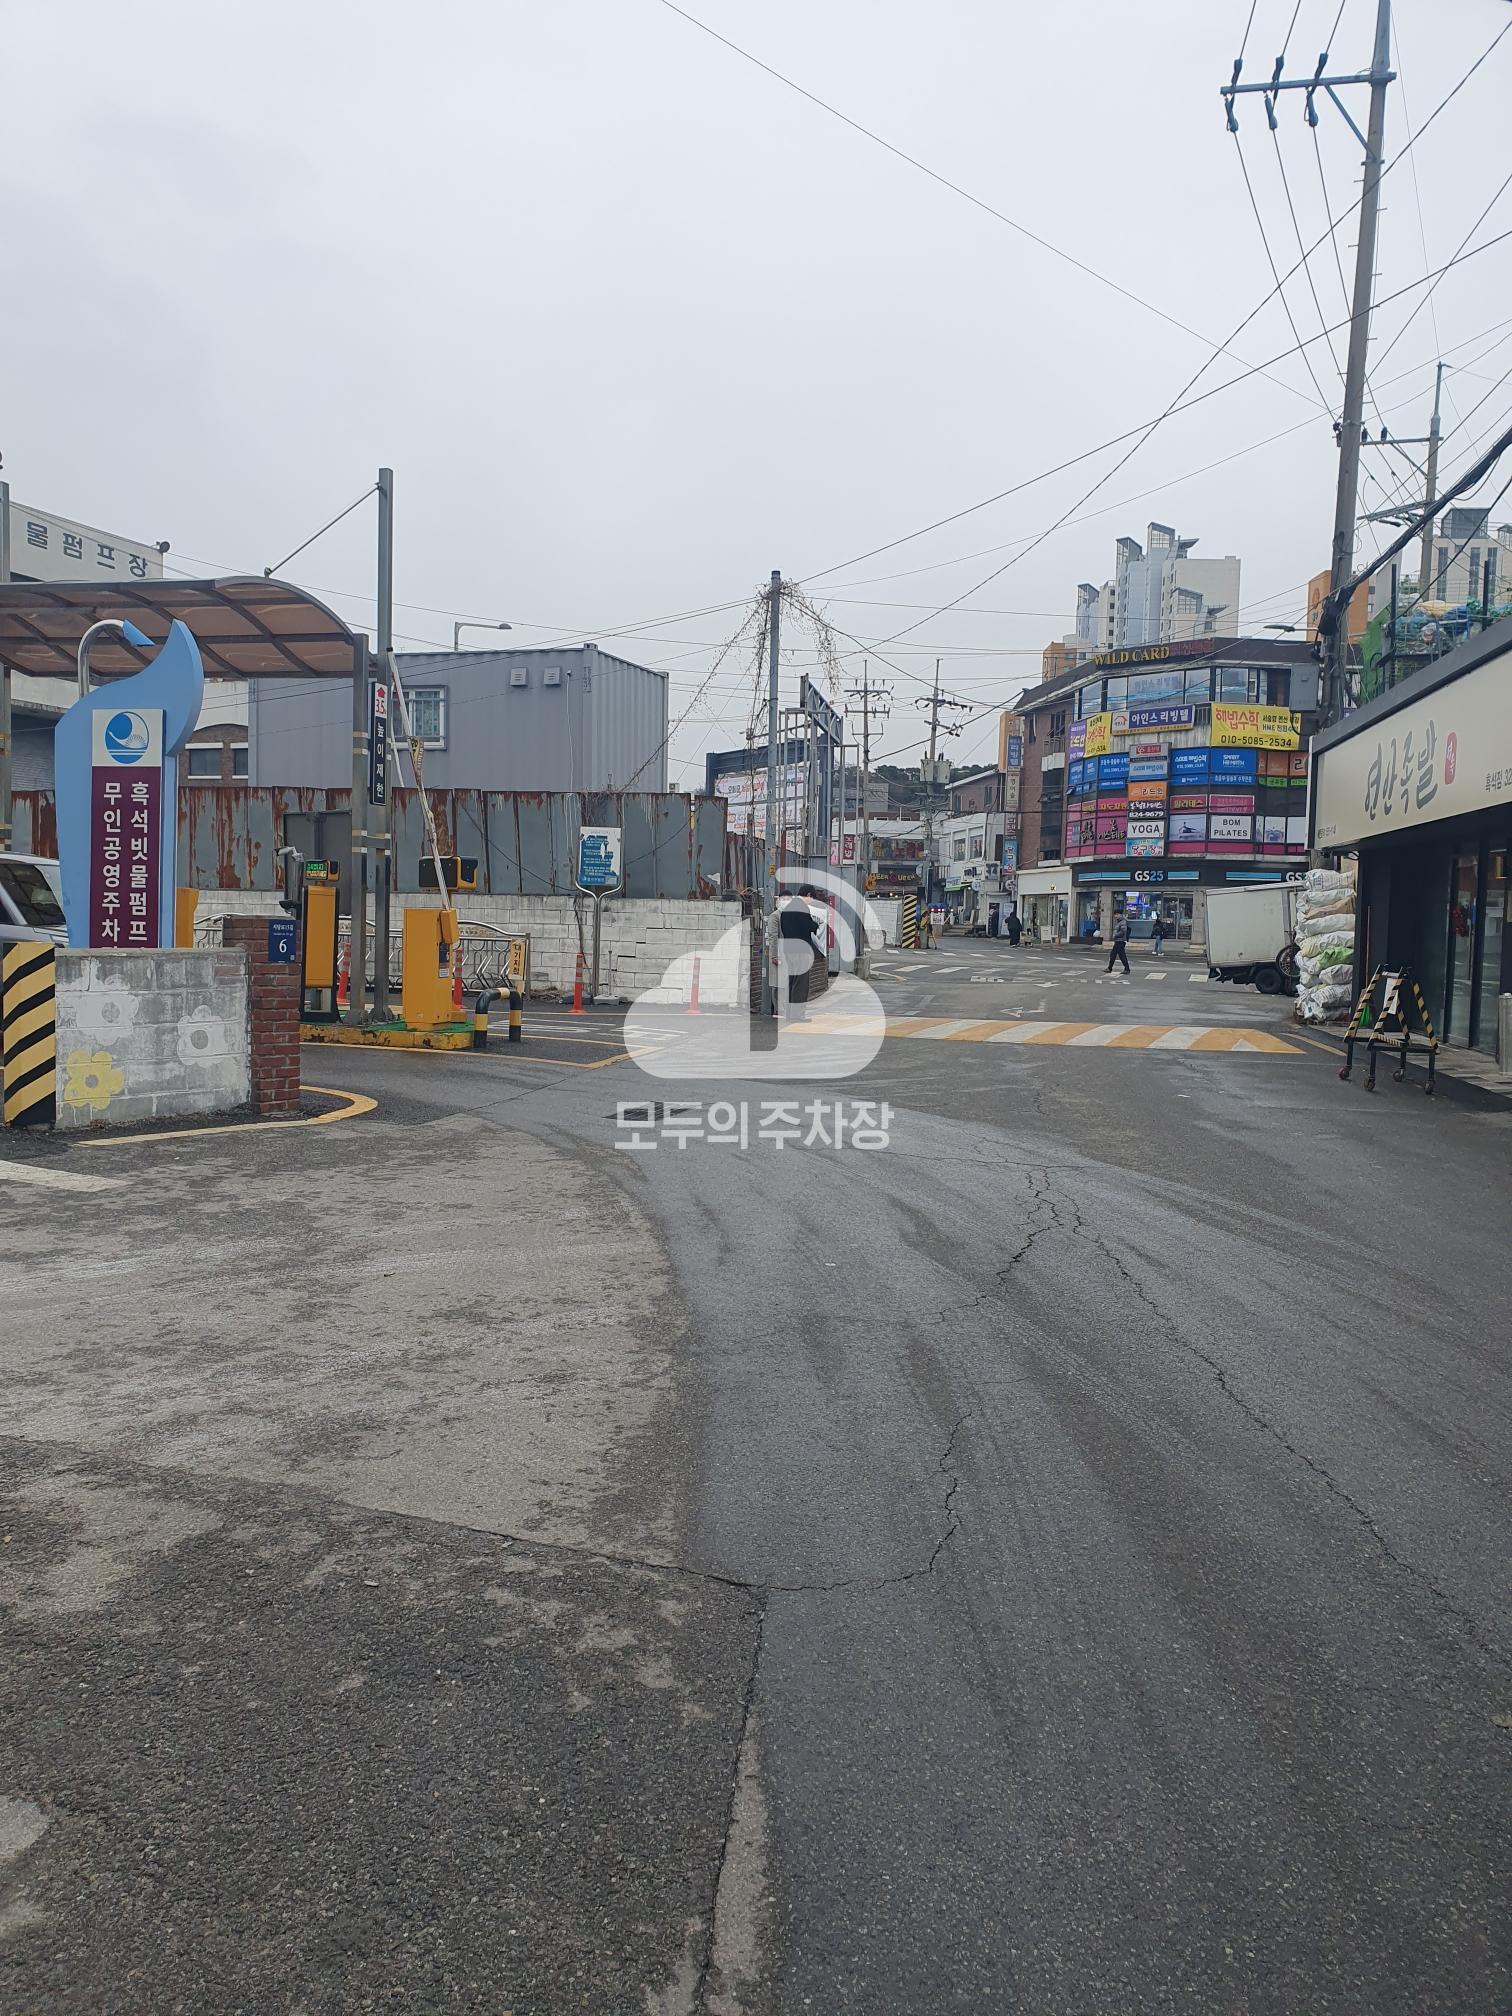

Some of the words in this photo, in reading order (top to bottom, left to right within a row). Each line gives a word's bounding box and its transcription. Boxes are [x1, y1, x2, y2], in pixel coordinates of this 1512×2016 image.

[27, 521, 148, 578] 물펌프장
[1092, 651, 1128, 665] WILD
[1132, 646, 1170, 662] CARD
[1131, 712, 1158, 726] 아인스
[1160, 708, 1189, 723] 리빙텔
[1220, 735, 1292, 747] 010-5085-2534
[376, 722, 385, 798] 높이제한
[1485, 772, 1503, 793] 흑석점
[1131, 824, 1161, 834] YOGA
[1222, 818, 1241, 826] BOM
[1213, 829, 1248, 837] PILATES
[101, 782, 122, 949] 무인공영주차
[129, 781, 150, 949] 흑석빗물펌프
[1134, 869, 1165, 882] GS25
[279, 938, 287, 953] 6
